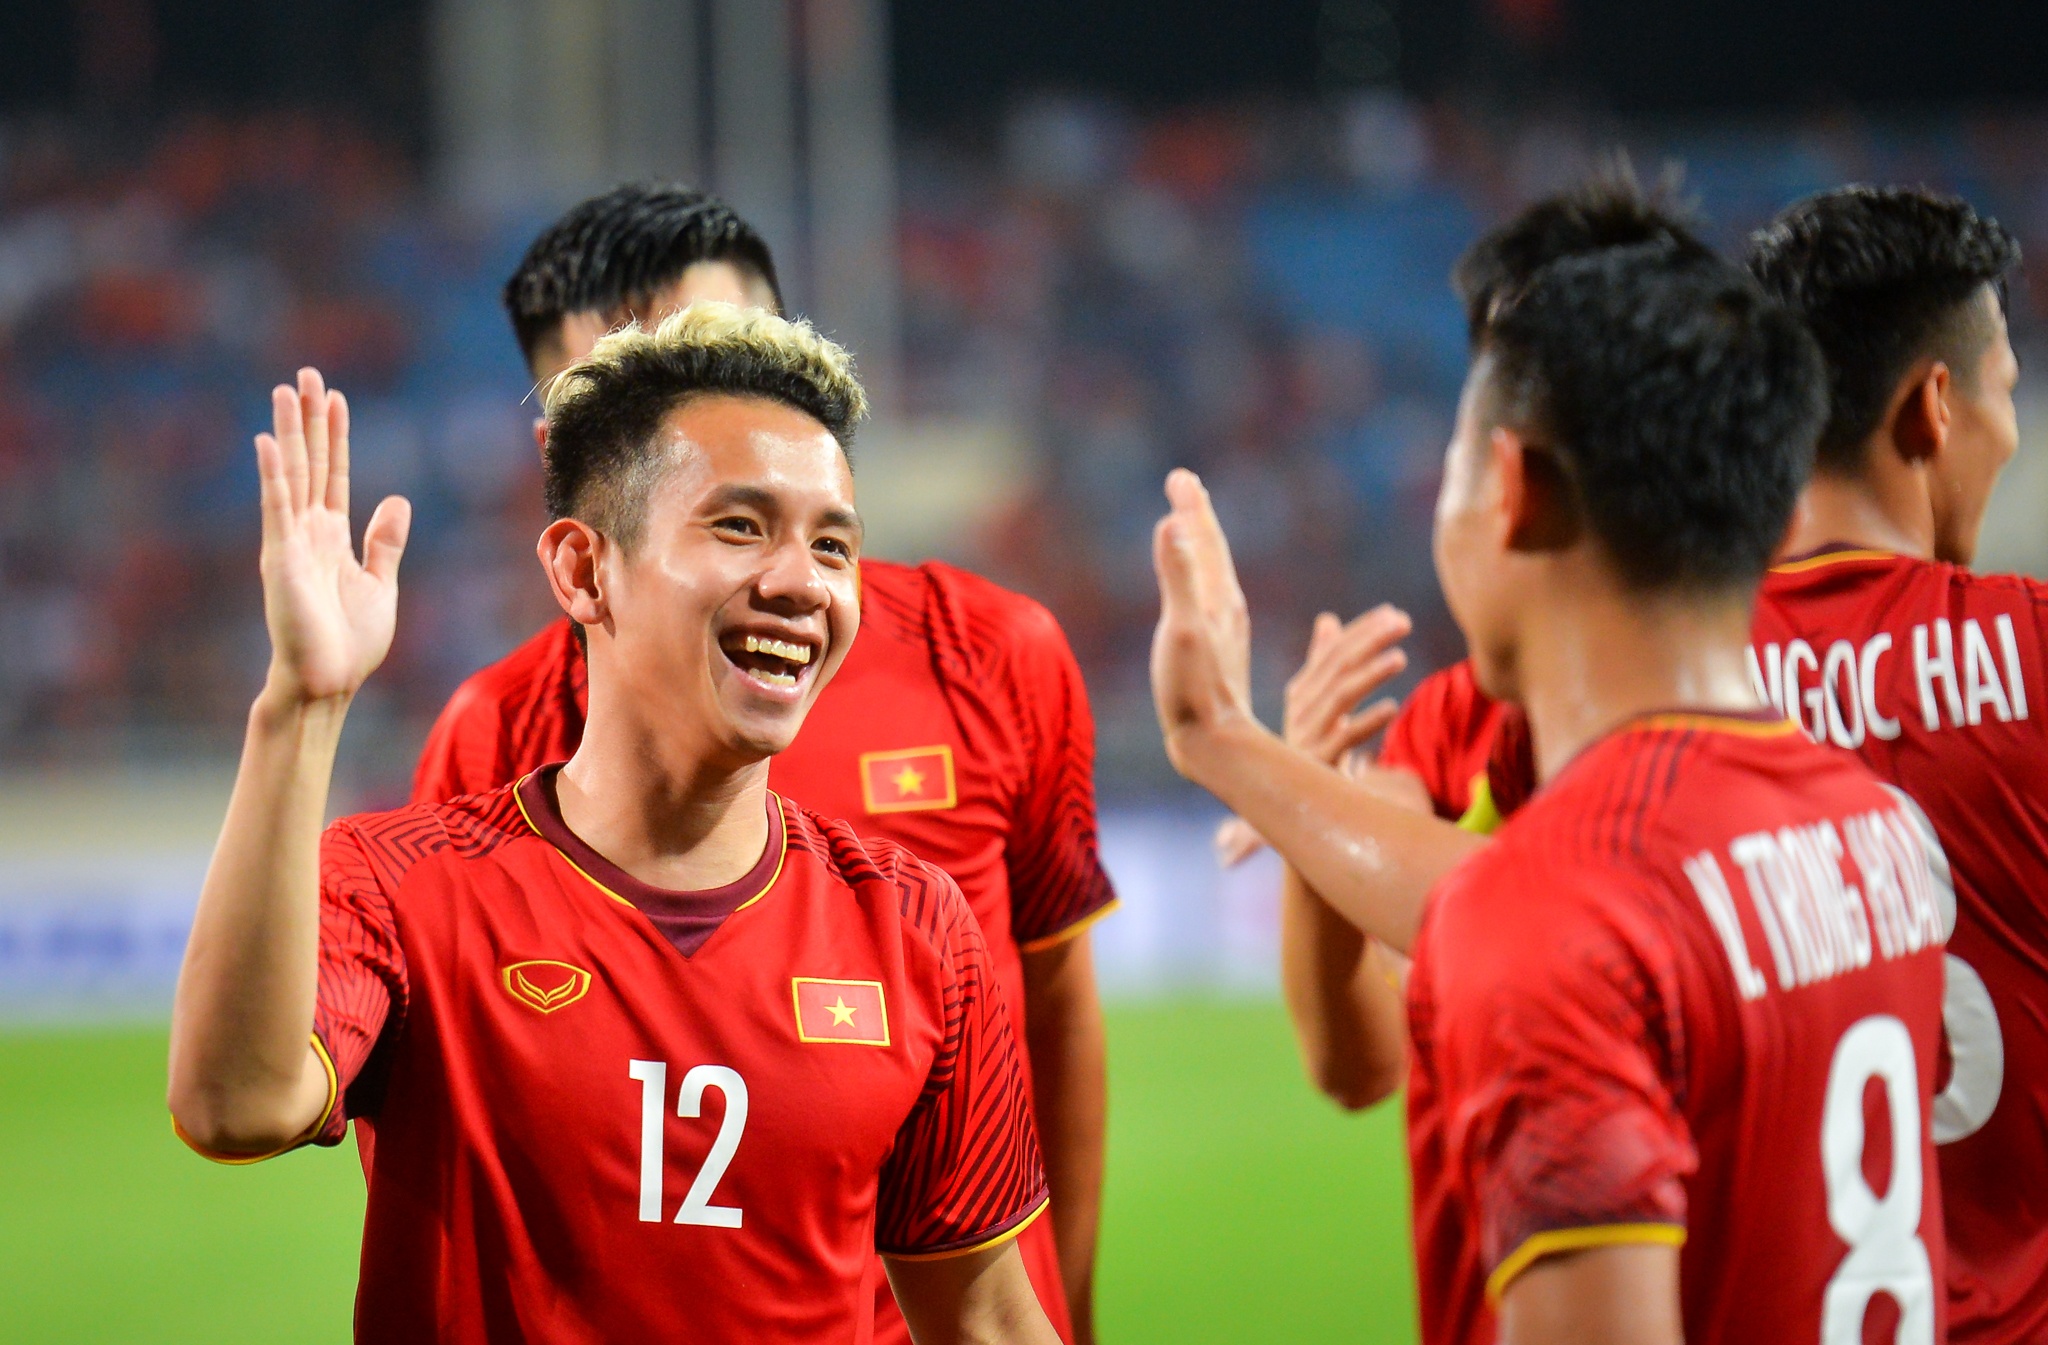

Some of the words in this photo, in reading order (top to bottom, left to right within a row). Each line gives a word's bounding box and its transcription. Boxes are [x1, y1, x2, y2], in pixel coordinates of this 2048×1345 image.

[1912, 613, 2029, 733] HAI
[1728, 817, 1872, 992] TRONG
[1842, 808, 1945, 961] HOA
[629, 1059, 749, 1228] 12
[1820, 1014, 1935, 1345] 8
